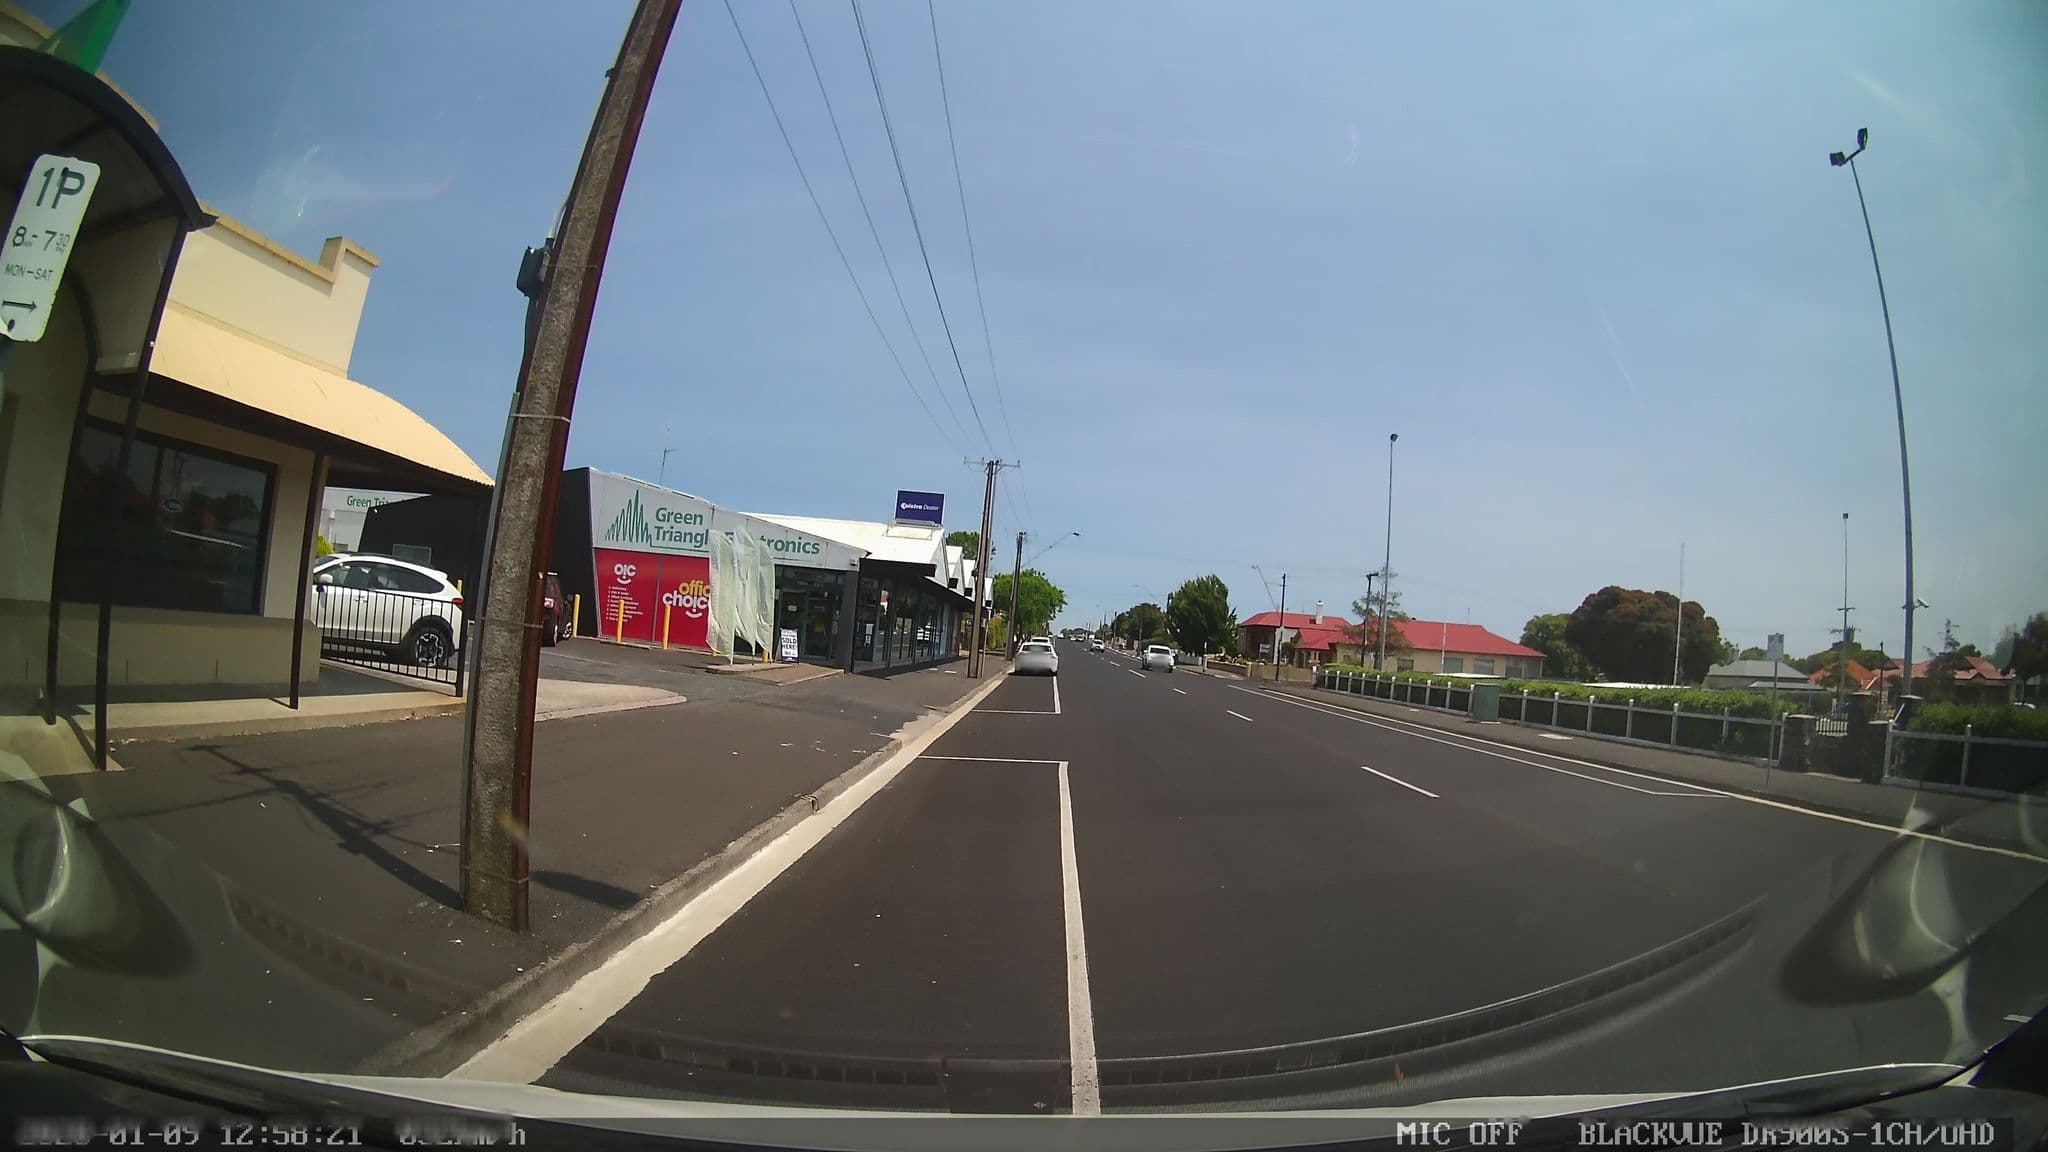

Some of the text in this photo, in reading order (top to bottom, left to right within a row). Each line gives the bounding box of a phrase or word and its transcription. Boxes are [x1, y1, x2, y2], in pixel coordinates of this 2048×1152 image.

[36, 167, 85, 208] 1P
[4, 264, 54, 280] MON-SAT
[347, 496, 371, 507] Green
[655, 507, 703, 526] Green
[655, 526, 709, 548] Triangl
[679, 580, 710, 597] offic
[662, 590, 709, 612] choic
